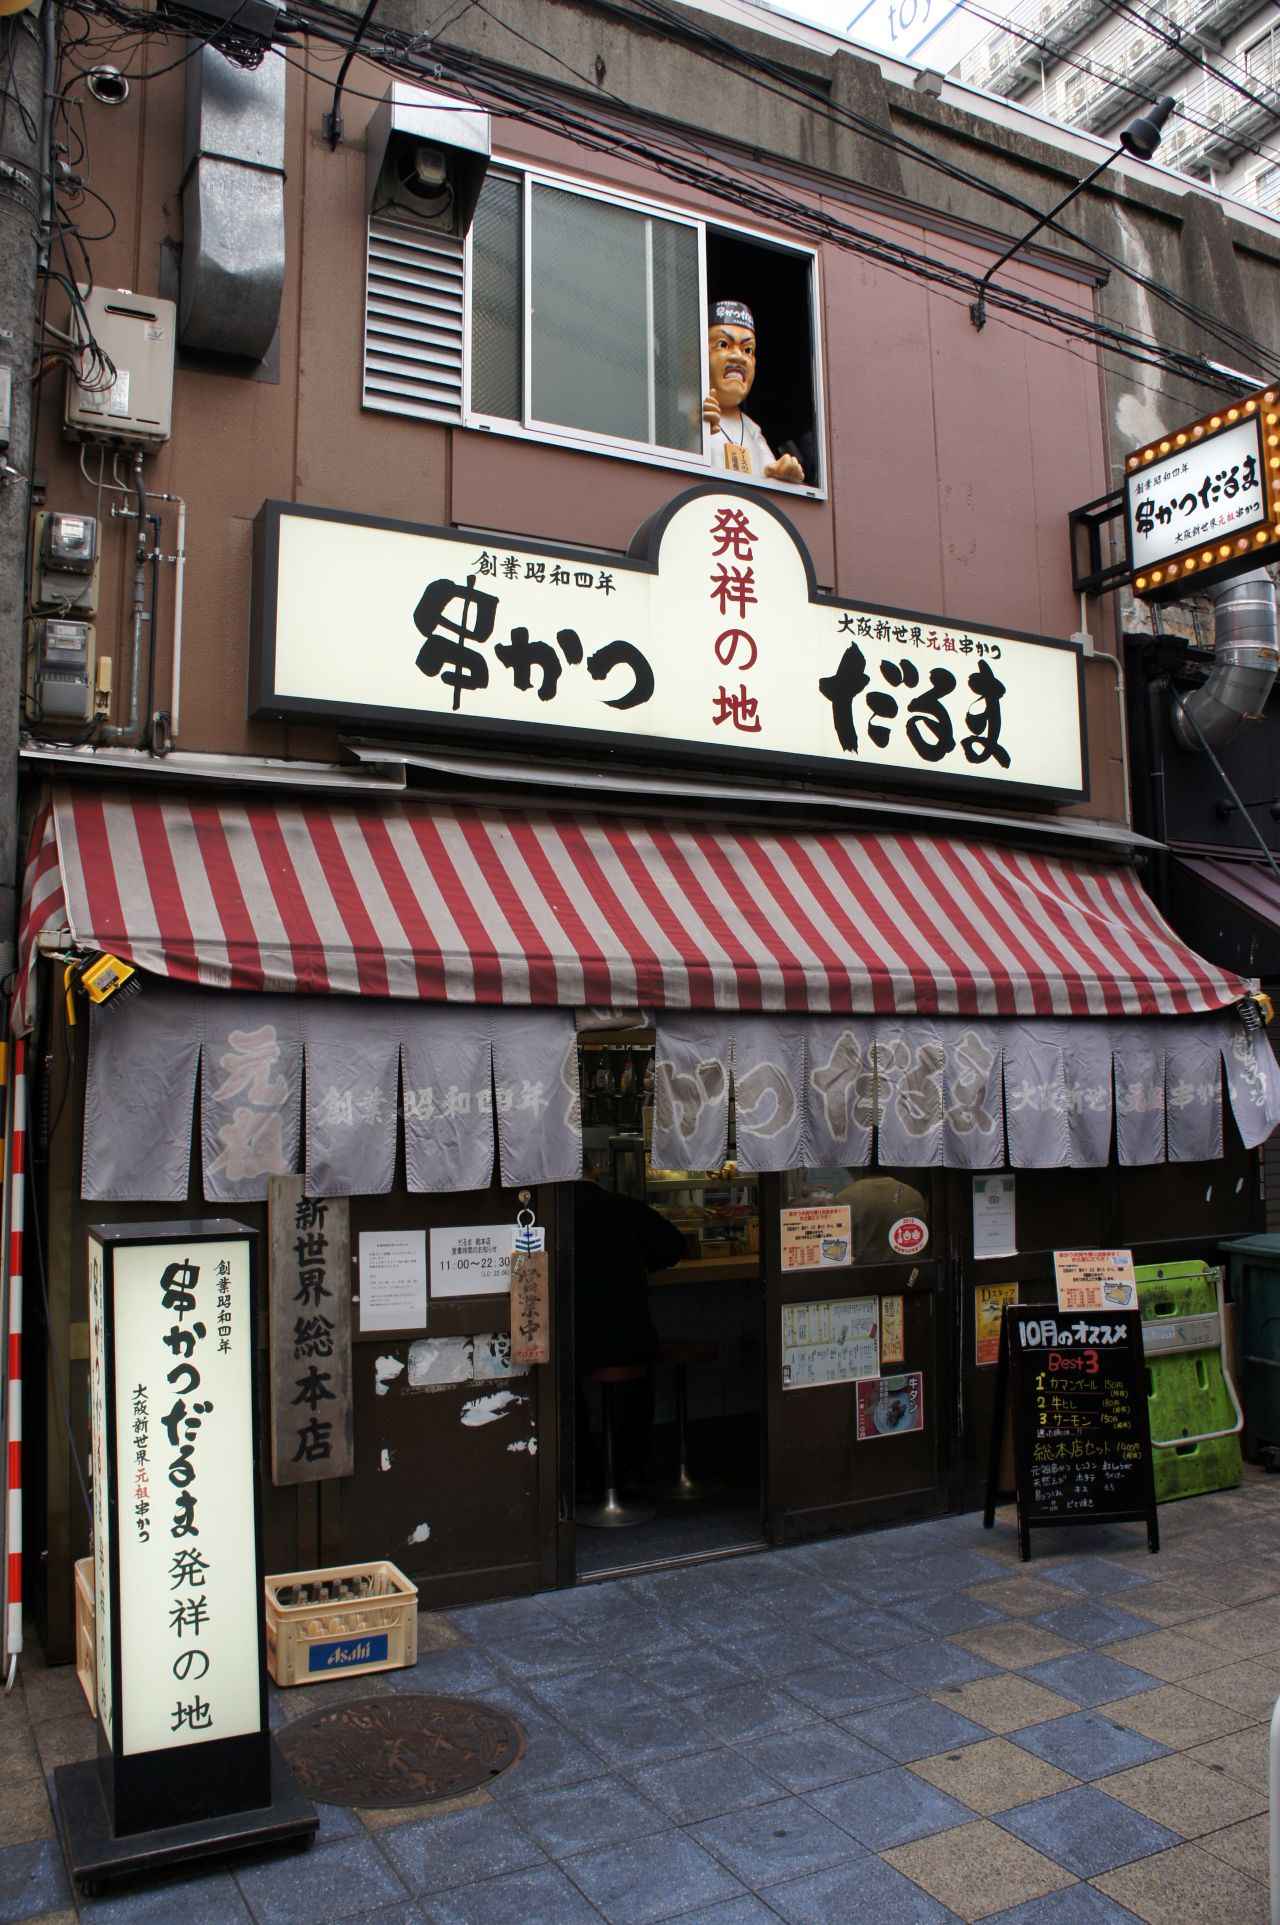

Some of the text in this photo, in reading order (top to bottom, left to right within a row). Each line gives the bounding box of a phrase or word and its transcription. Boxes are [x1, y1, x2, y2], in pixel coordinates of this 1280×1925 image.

[1135, 463, 1190, 494] 創業昭和四年
[1135, 454, 1259, 540] 串かつだるま
[1174, 502, 1260, 544] 大阪新世界元祖串かつ
[471, 550, 617, 596] 創業昭和四年
[413, 575, 655, 711] 串かつ
[709, 508, 762, 733] 発祥の地
[837, 613, 1002, 660] 大阪新世界元祖串かつ
[818, 640, 1011, 769] だるま
[215, 1258, 232, 1355] 創業昭和四年
[290, 1195, 337, 1463] 新世界総本店
[1018, 1319, 1127, 1346] 10月のオススメ
[1036, 1396, 1045, 1408] 2
[1039, 1413, 1047, 1424] 3
[1053, 1414, 1092, 1427] サーモン
[132, 1383, 151, 1544] 大阪新世界元祖串かつ
[1033, 1438, 1111, 1460] 総本店セット
[327, 1641, 371, 1666] Asahi
